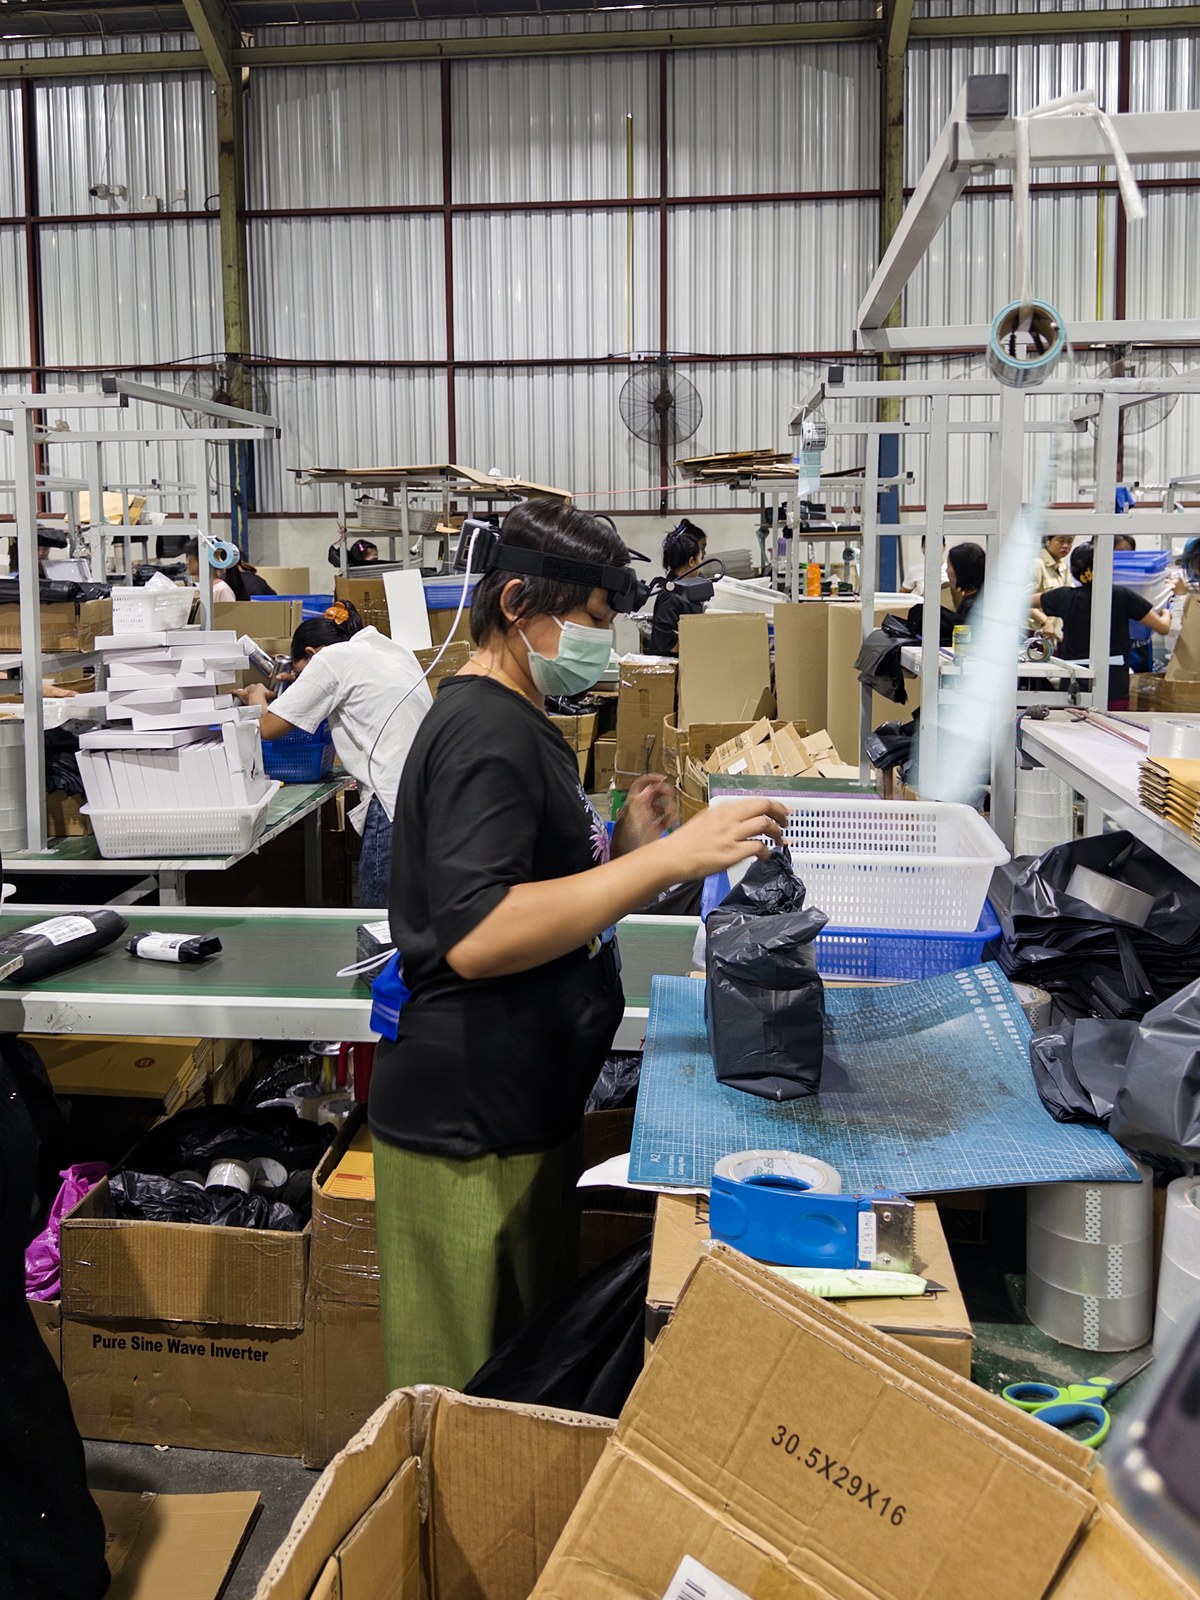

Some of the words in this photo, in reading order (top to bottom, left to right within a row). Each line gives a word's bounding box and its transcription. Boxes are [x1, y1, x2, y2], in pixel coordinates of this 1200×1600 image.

[650, 1153, 661, 1162] A2
[92, 1334, 127, 1350] Pure
[131, 1335, 163, 1352] Sine
[167, 1338, 206, 1356] Wave
[210, 1342, 269, 1362] Inverter
[771, 1424, 907, 1526] 30.5X29X16
